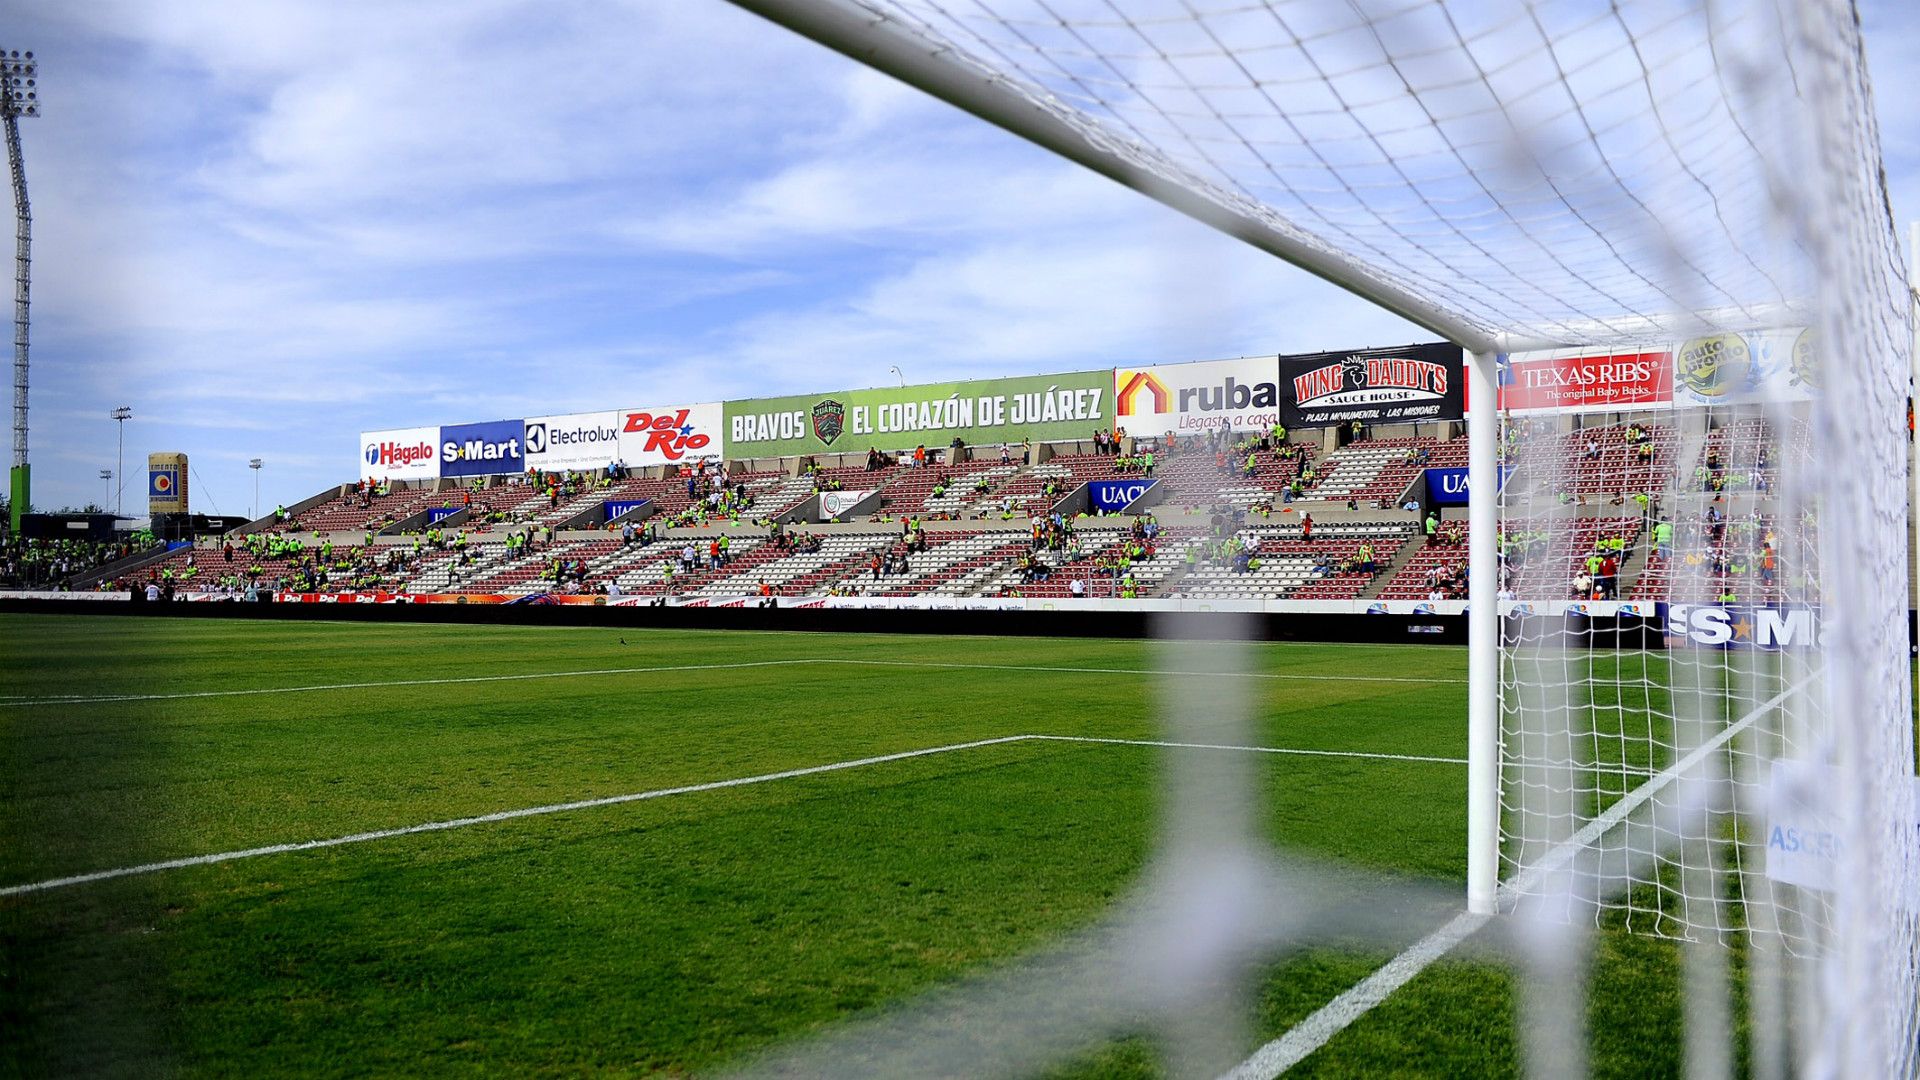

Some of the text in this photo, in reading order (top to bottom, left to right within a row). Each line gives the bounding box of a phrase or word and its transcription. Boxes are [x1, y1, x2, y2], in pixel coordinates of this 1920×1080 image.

[1683, 340, 1725, 362] auto
[1294, 358, 1447, 404] WING DADDY'S
[1522, 365, 1596, 388] TEXAS
[1179, 376, 1278, 412] ruba
[1329, 391, 1411, 404] SAUCE HOUSE
[1545, 390, 1561, 400] The
[1563, 389, 1596, 400] original
[1597, 387, 1620, 398] Baby
[623, 409, 690, 432] Del
[732, 385, 1103, 442] BRAVOS EL CORAZÓN DE JUÁREZ
[1179, 413, 1277, 432] Llegaste a casa
[1305, 405, 1441, 423] PLAZA MONUMENTAL LAS MISIONES
[550, 425, 618, 445] Electrolux
[643, 430, 710, 460] Rio
[380, 441, 433, 465] Hágalo
